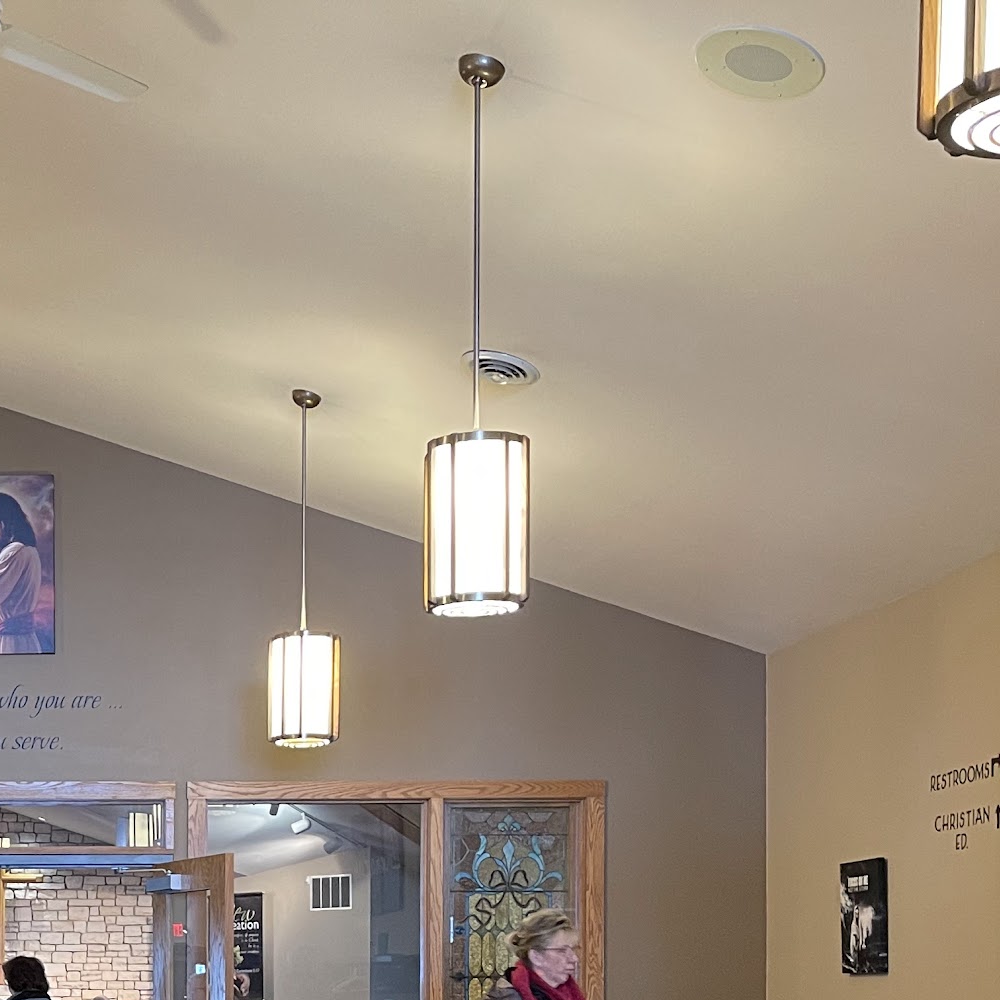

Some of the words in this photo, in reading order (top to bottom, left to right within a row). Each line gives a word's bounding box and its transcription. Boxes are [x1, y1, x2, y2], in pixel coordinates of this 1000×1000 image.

[29, 695, 66, 719] you
[71, 695, 102, 709] are
[11, 736, 64, 750] serve.
[930, 762, 990, 792] RESTROOMS
[934, 805, 990, 832] CHRISTIAN
[955, 833, 969, 850] ED.
